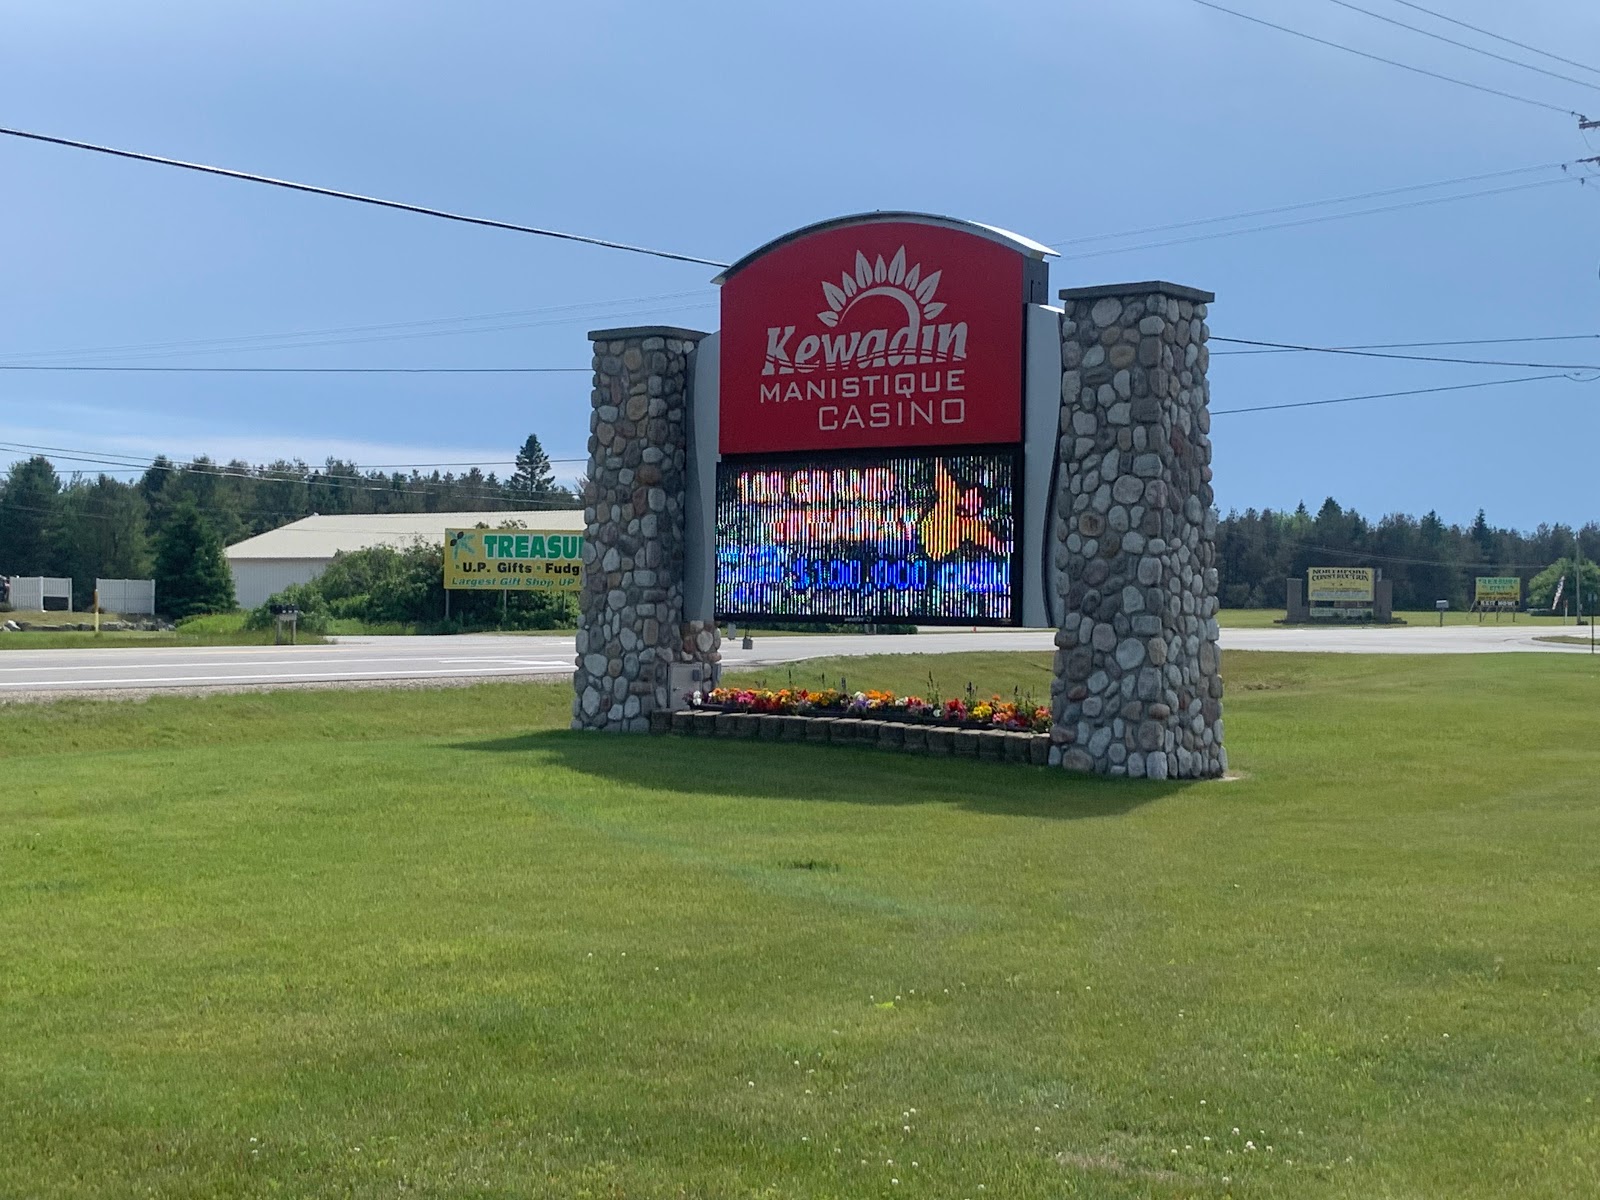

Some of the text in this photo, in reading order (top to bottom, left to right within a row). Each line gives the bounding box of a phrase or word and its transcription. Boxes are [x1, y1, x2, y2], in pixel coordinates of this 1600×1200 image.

[761, 321, 968, 376] Kewadin
[760, 369, 965, 403] MANISTIQUE
[818, 399, 965, 431] CASINO
[452, 577, 575, 588] Largest Gift Shop UP
[462, 562, 582, 576] U.P. Gifts Fudg
